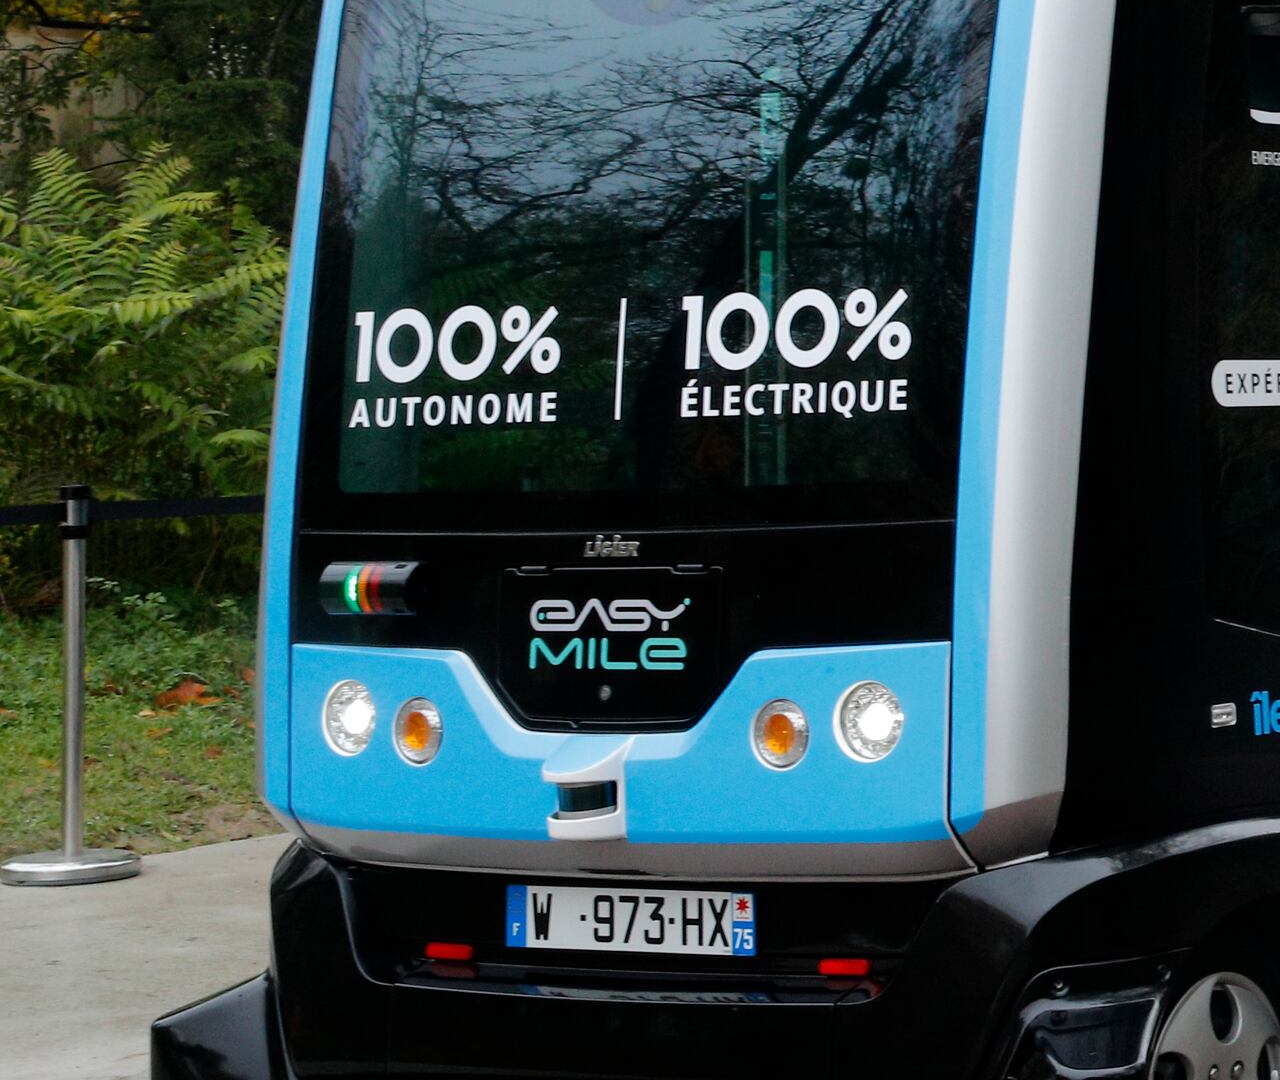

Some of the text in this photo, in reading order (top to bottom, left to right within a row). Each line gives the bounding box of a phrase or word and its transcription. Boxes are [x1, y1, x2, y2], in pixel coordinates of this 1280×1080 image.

[355, 288, 912, 383] 100% 100%
[348, 379, 908, 428] AUTONOME ÉLECTRIQUE
[512, 923, 521, 936] F
[532, 893, 552, 940] W
[733, 928, 753, 950] 75
